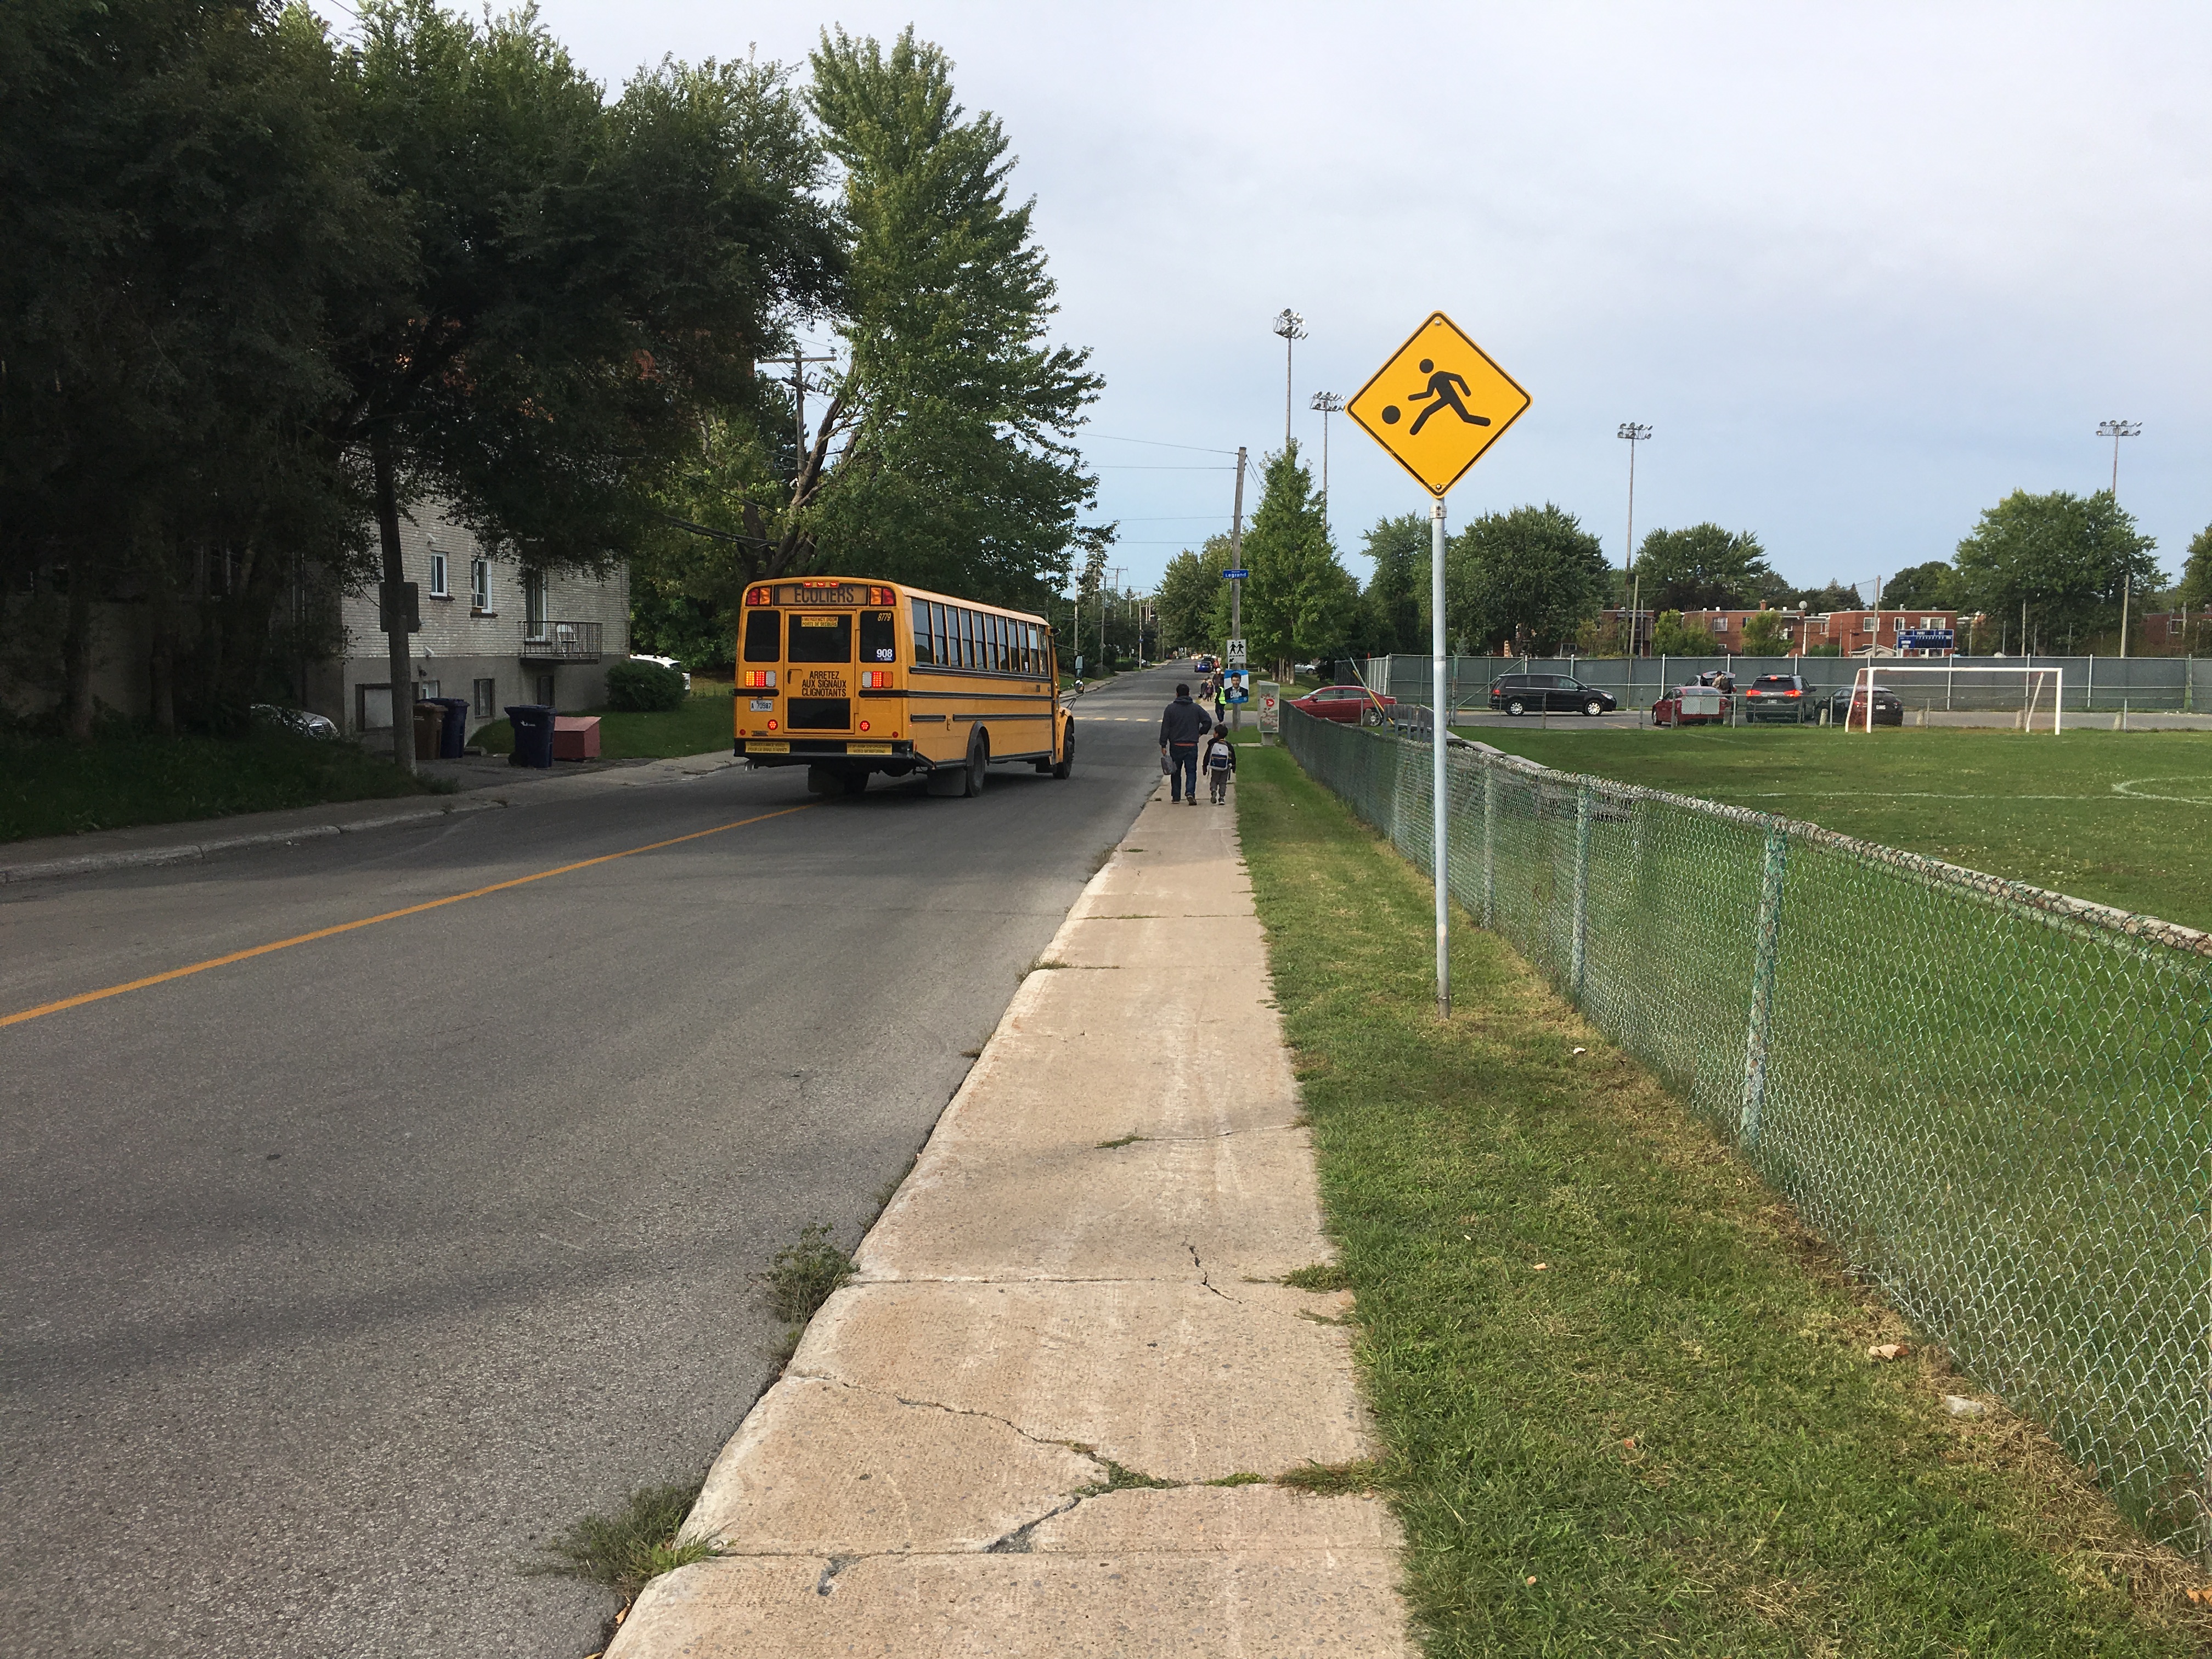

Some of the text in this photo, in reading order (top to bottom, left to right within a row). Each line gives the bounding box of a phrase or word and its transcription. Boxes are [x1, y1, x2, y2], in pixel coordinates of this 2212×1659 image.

[878, 613, 891, 621] 8779
[876, 648, 893, 658] 908
[809, 671, 839, 679] ARRETEZ
[802, 680, 847, 688] AUX SIGNAUX
[802, 688, 847, 697] CLIGNOTANTS
